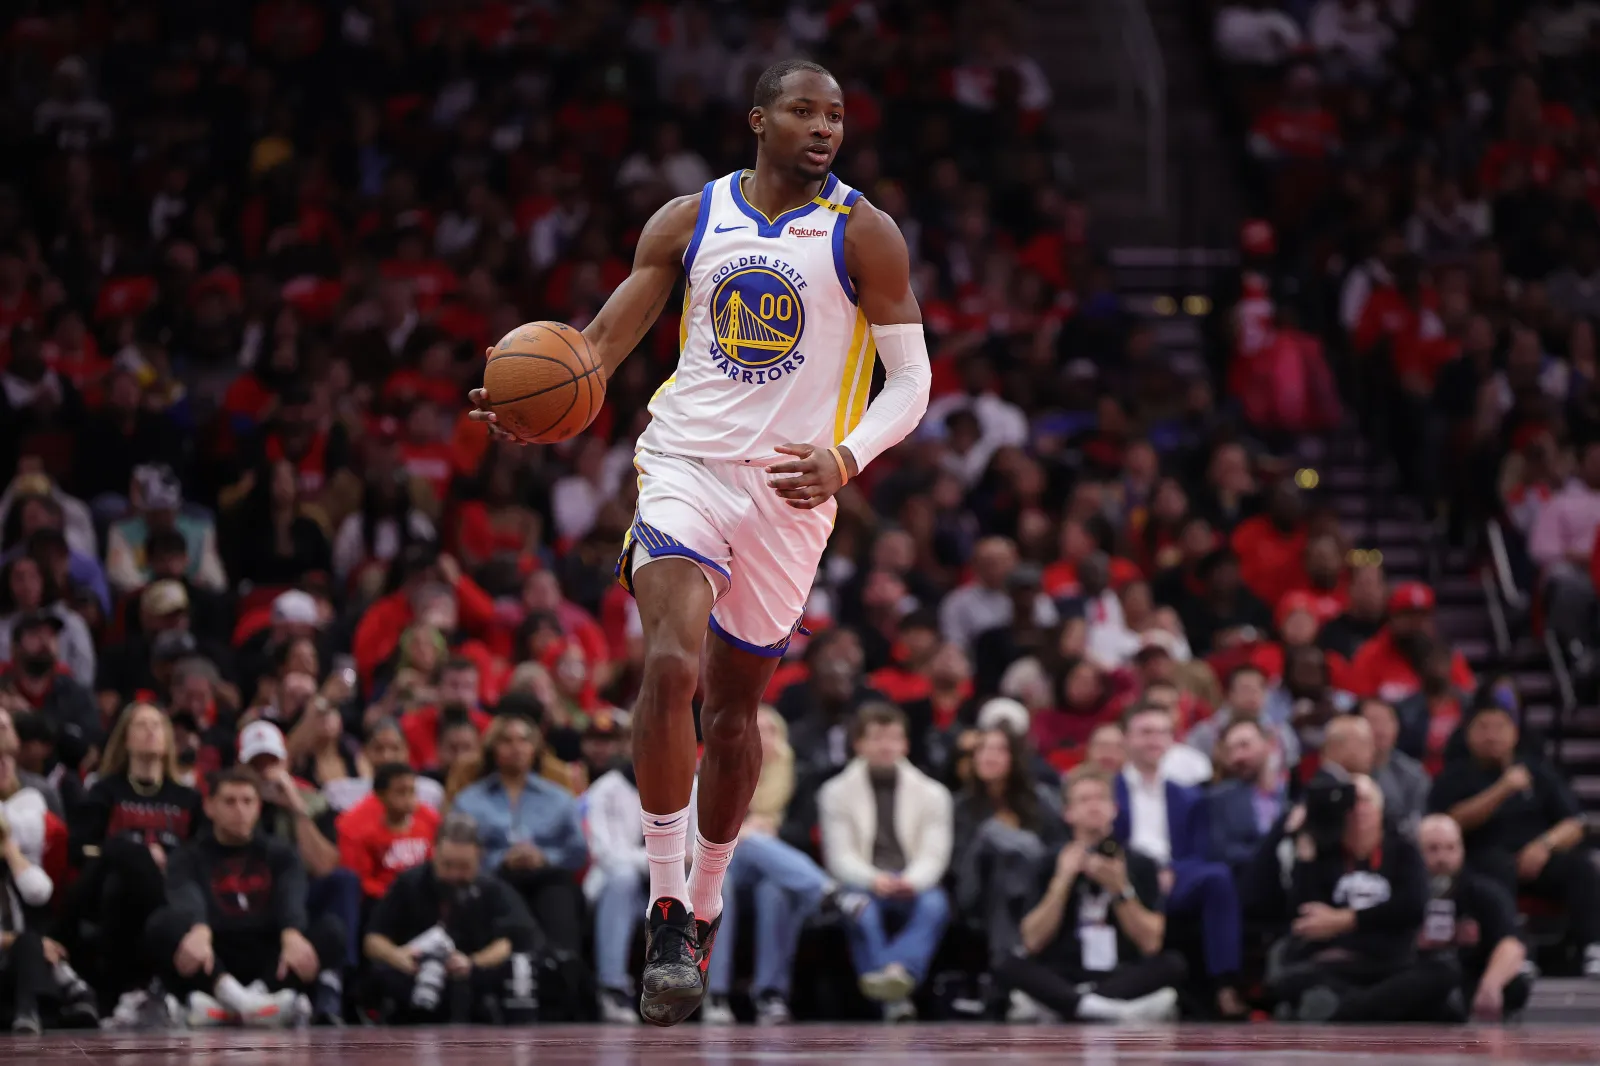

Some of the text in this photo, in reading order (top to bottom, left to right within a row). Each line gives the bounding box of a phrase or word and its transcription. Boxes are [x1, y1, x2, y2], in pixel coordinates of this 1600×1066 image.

[788, 226, 828, 237] Rakuten
[712, 255, 808, 291] GOLDEN STATE
[760, 293, 792, 321] 00
[709, 341, 805, 385] WARRIORS
